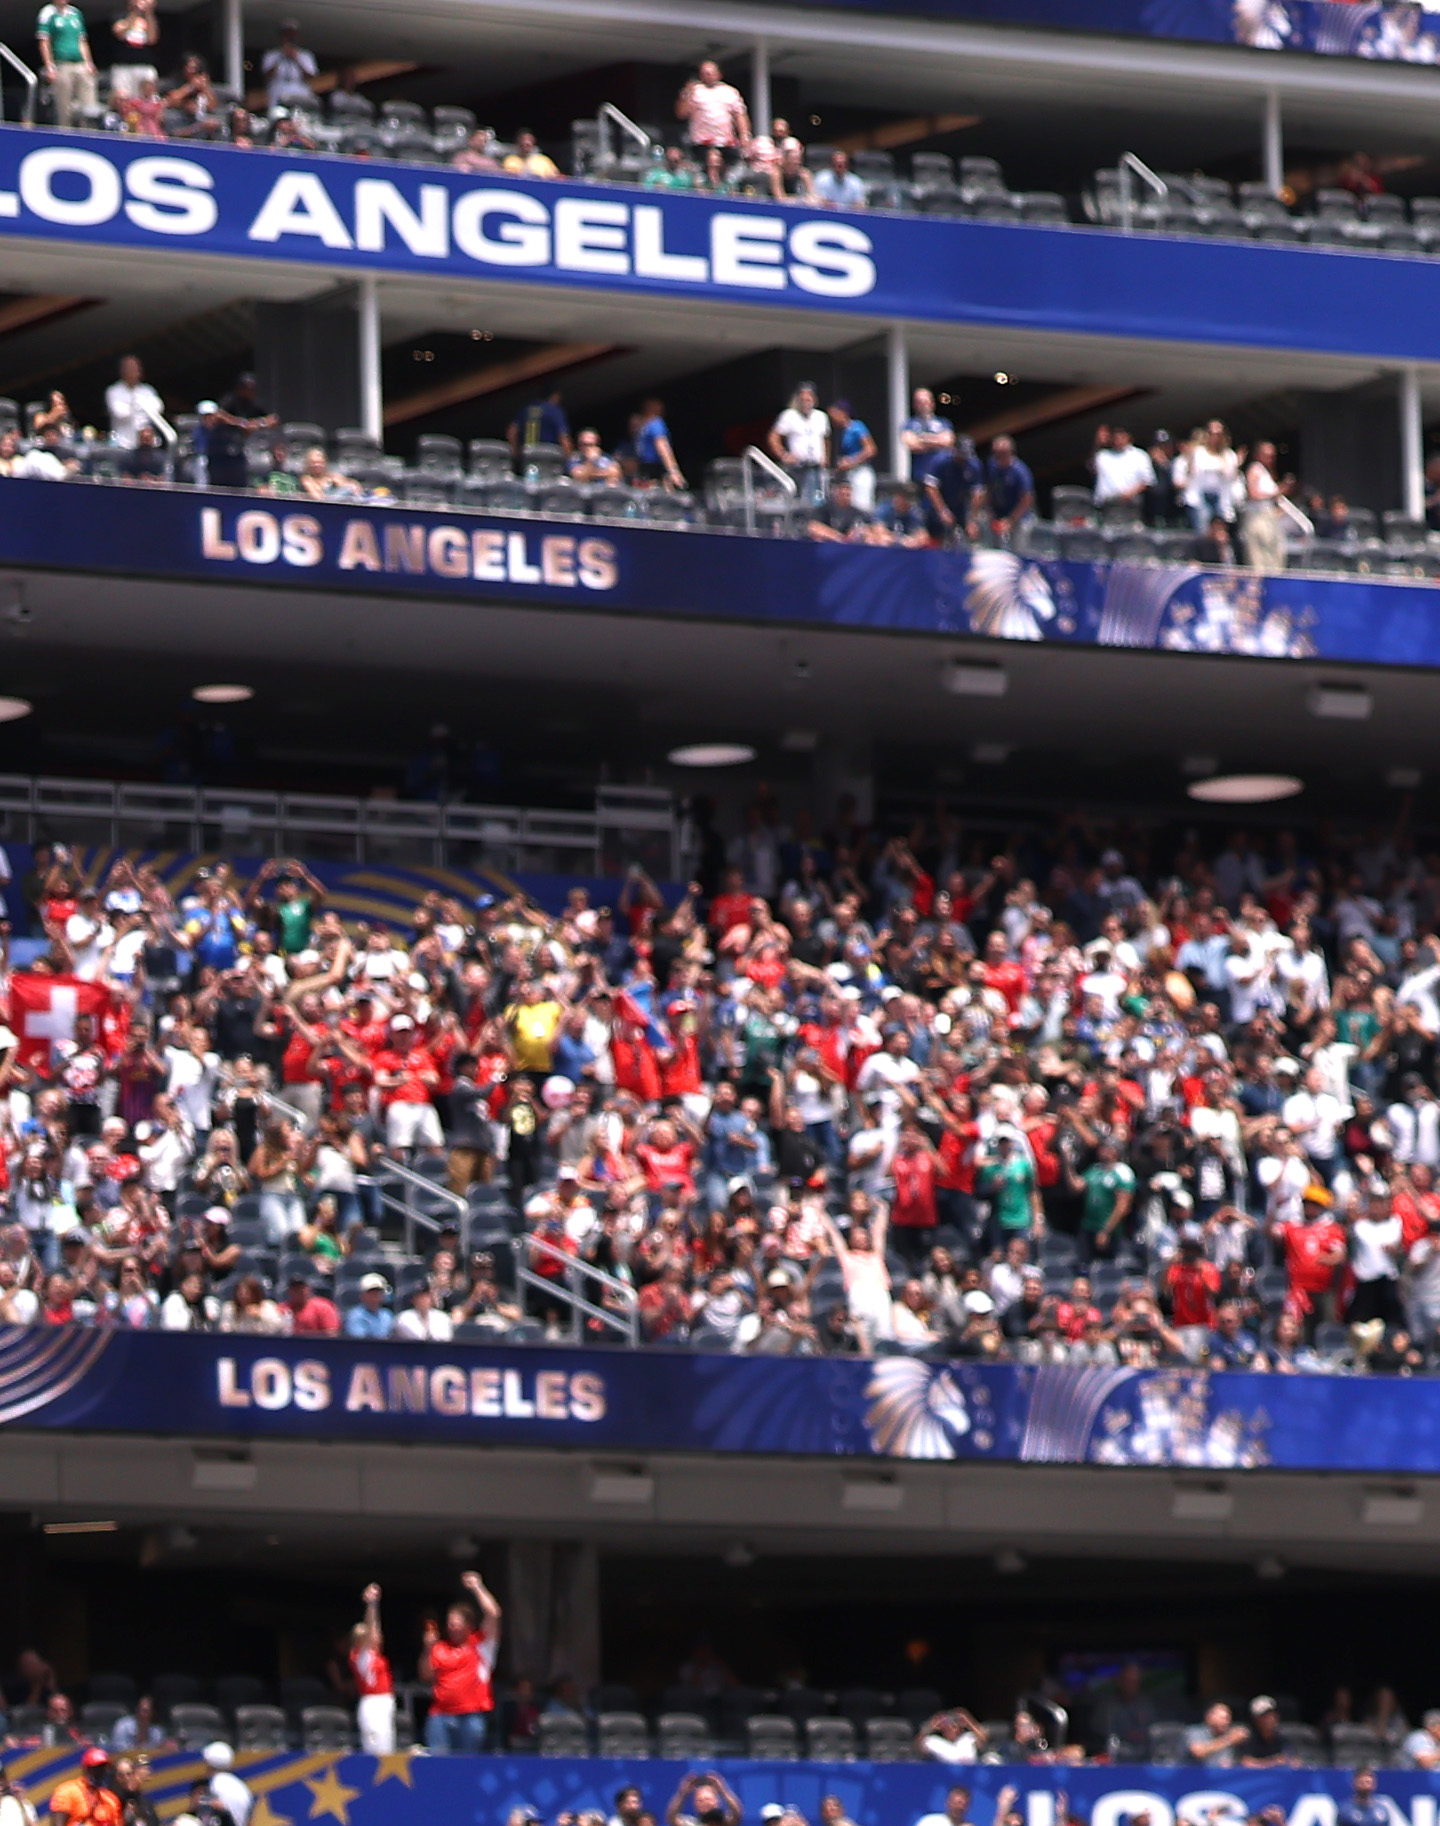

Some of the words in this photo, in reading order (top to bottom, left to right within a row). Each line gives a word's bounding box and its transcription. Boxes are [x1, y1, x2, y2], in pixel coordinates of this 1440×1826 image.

[247, 183, 877, 299] ANGELES
[201, 508, 323, 567] LOS
[338, 518, 618, 590] ANGELES
[218, 1357, 331, 1411] LOS
[346, 1363, 604, 1422] ANGELES
